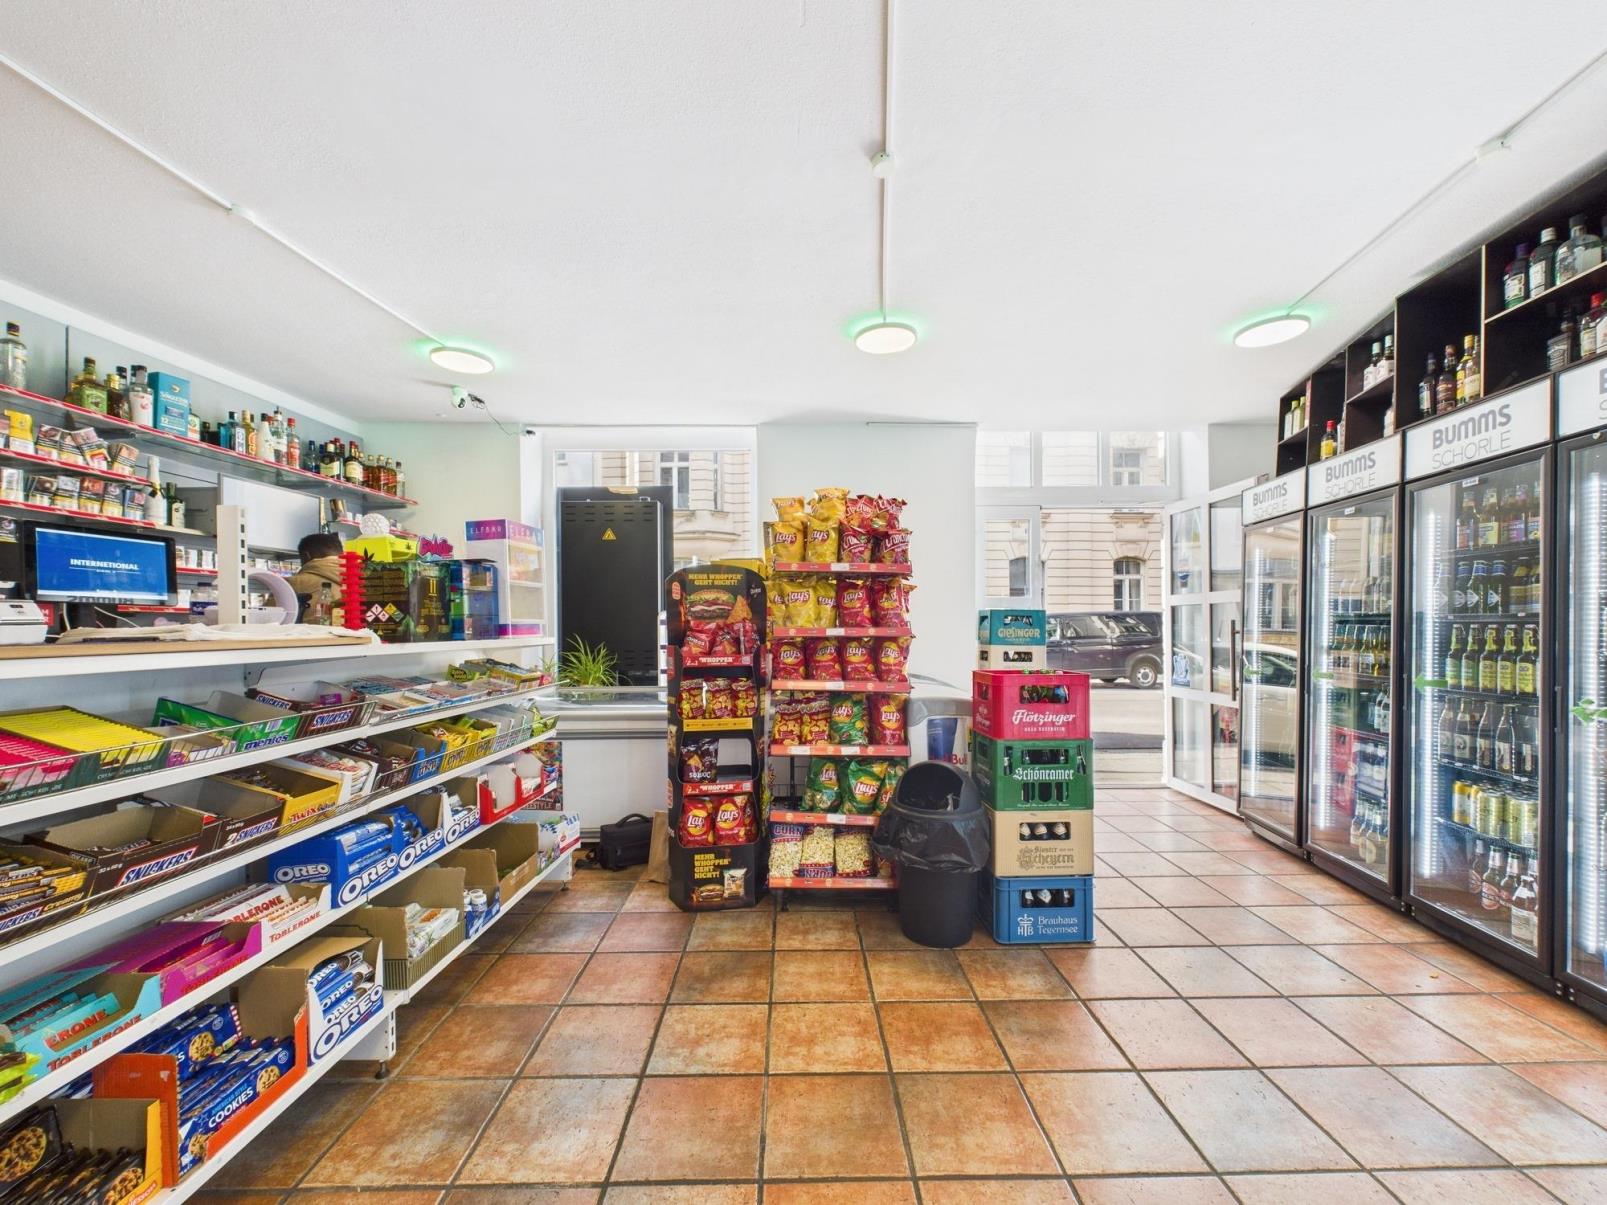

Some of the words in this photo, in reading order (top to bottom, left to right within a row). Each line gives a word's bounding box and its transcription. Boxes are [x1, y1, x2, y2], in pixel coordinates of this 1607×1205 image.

[1432, 430, 1511, 470] SCHORLE
[1325, 471, 1376, 499] SCHORLE
[1253, 499, 1288, 519] SCHORLE
[256, 694, 291, 710] SNICKERS
[1012, 709, 1076, 726] Flötzinger
[243, 734, 289, 751] mentos
[1012, 766, 1074, 783] Schönramer
[237, 819, 277, 842] SNICKERS
[446, 809, 480, 844] OREO
[399, 827, 444, 871] OREO
[694, 853, 716, 861] MEHR
[121, 849, 194, 885] SNICKERS
[274, 863, 332, 884] OREO
[338, 853, 399, 907] OREO
[268, 911, 322, 944] TOBLERONE
[1037, 926, 1079, 935] Tegernsee
[1038, 915, 1079, 926] Brauhaus
[308, 962, 338, 988] OREO
[321, 980, 354, 1010] OREO
[313, 984, 383, 1061] OREO
[325, 995, 357, 1025] OREO
[208, 1086, 255, 1129] COOKIES
